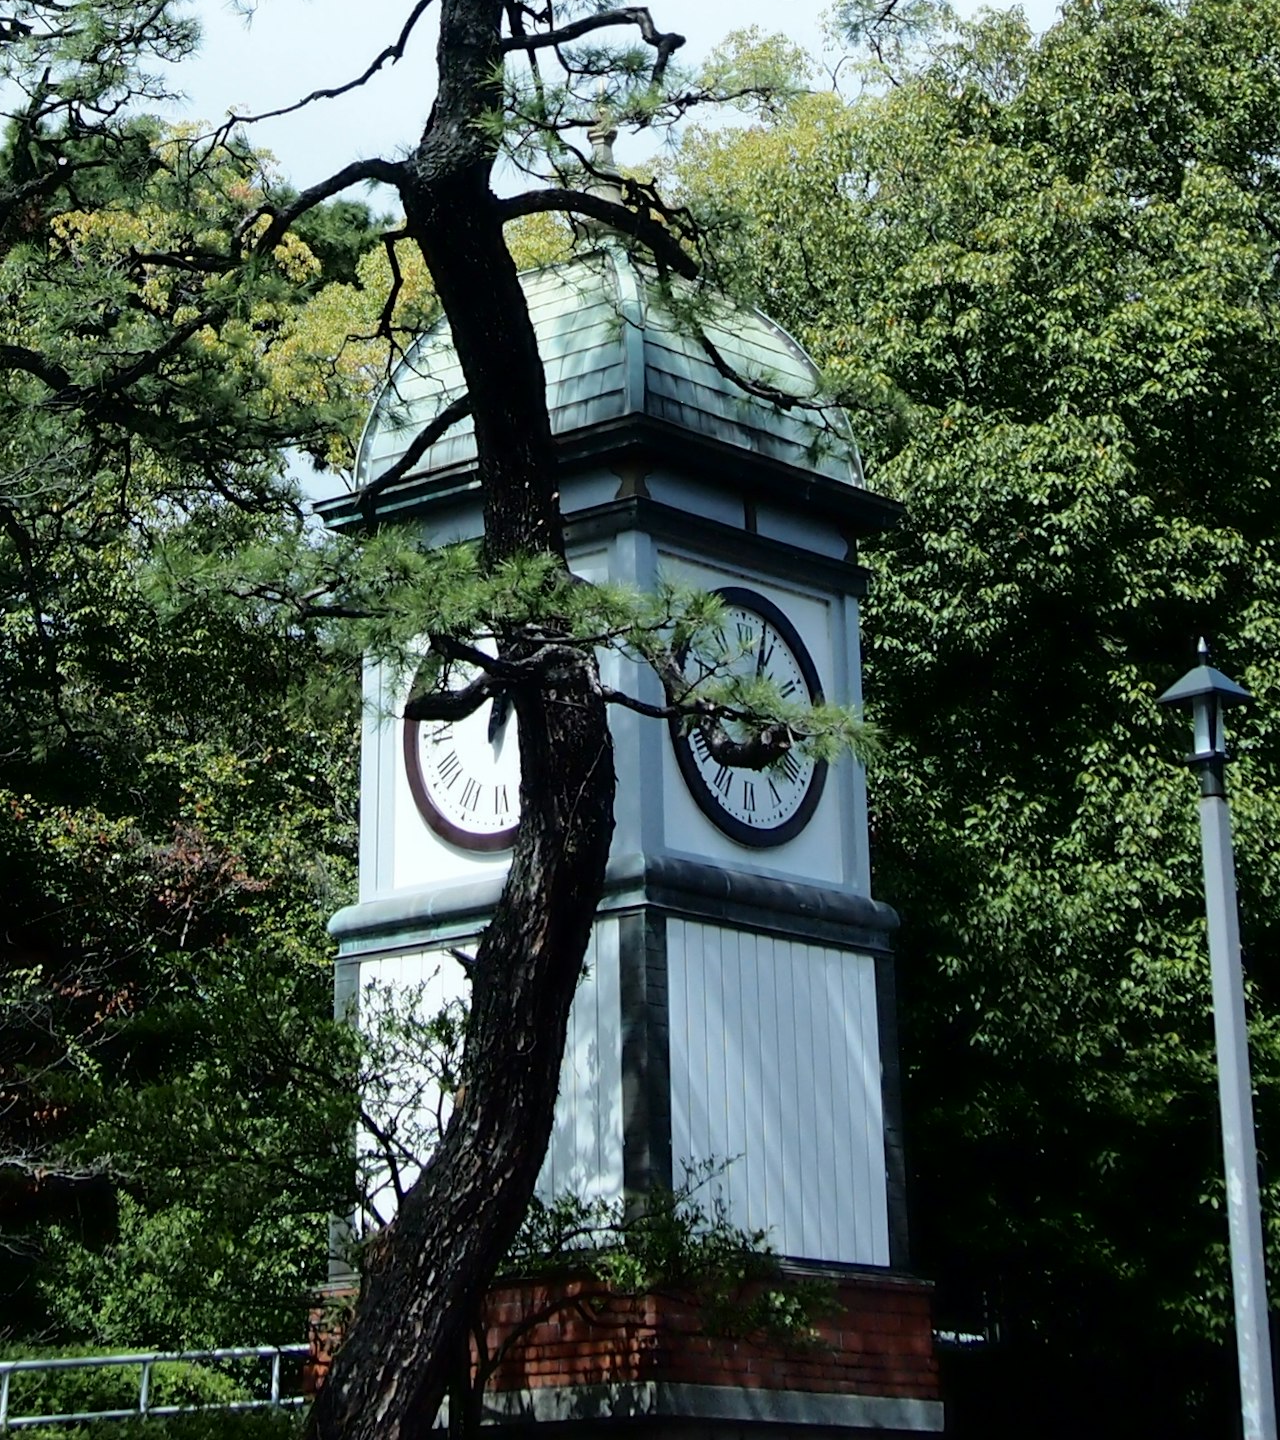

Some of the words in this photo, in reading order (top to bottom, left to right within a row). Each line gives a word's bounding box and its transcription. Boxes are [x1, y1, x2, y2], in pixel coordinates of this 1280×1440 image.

[437, 750, 463, 790] VIII
[460, 777, 482, 812] VII
[495, 784, 509, 815] VI
[744, 781, 756, 812] VI
